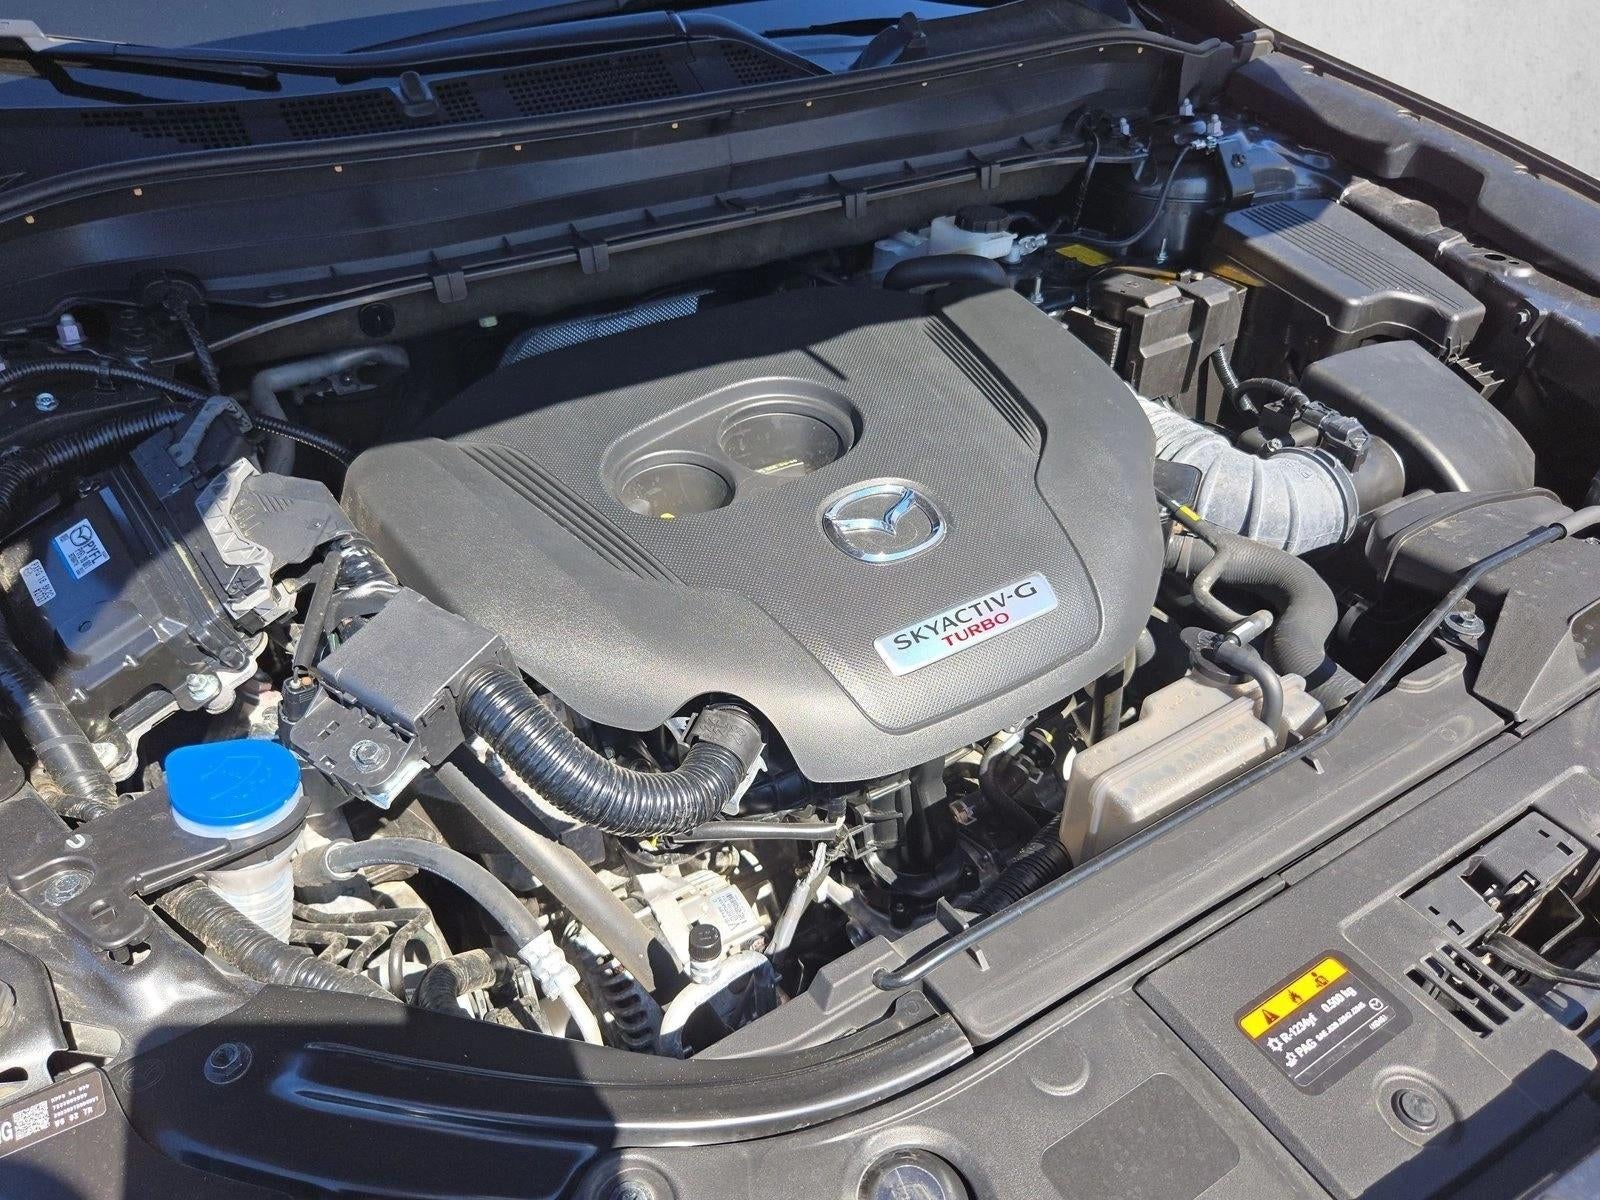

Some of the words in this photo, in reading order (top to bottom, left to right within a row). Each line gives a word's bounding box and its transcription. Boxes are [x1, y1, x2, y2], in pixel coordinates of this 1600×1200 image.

[86, 540, 102, 565] PYFL
[893, 581, 1037, 650] SKYACTIV-G
[942, 612, 1009, 647] TURBO
[1294, 1038, 1318, 1058] PAG
